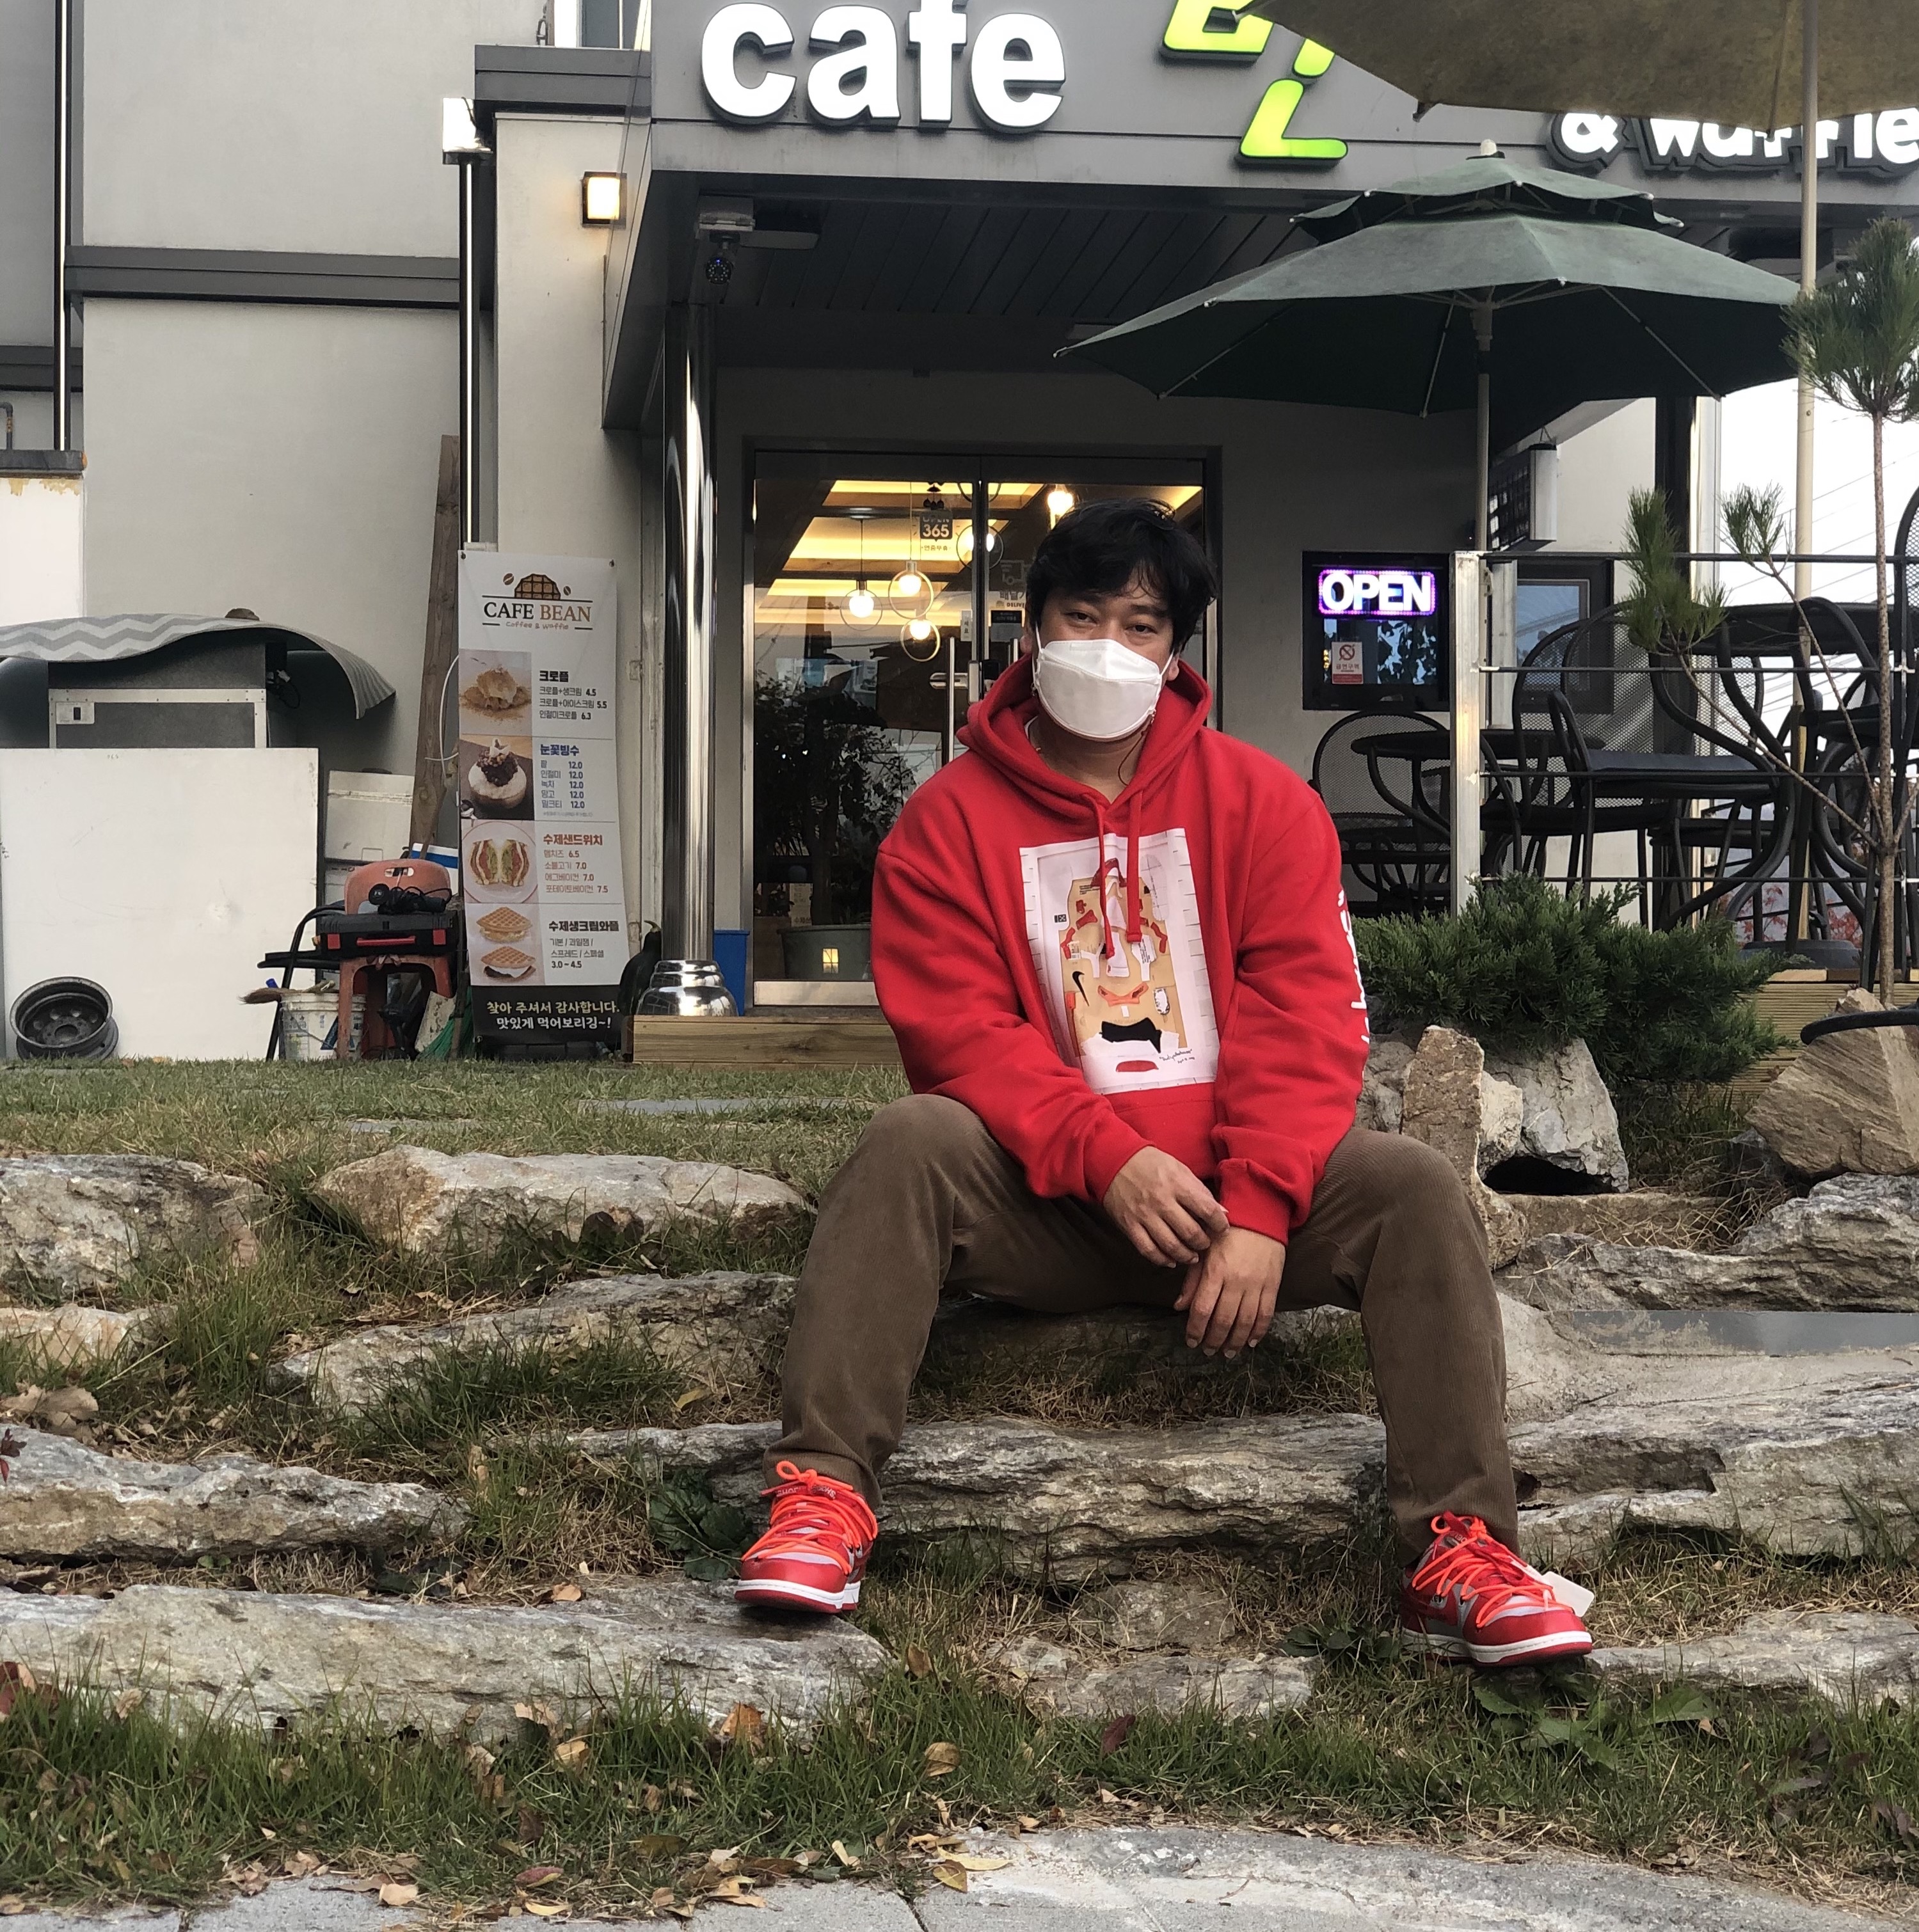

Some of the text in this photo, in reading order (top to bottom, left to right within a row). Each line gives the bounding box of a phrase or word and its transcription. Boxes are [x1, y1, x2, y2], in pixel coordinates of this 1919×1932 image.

[701, 0, 1066, 131] cafe
[1650, 107, 1919, 164] wale
[922, 524, 950, 537] 365
[1322, 572, 1432, 612] OPEN
[484, 601, 591, 622] CAFE BEAN
[539, 670, 568, 682] 크로플
[539, 686, 582, 696] 크로플+생크림
[539, 698, 594, 708] 크로플+아이스크림
[539, 710, 577, 720] 인절미크로플
[540, 744, 579, 756] 눈꽃빙수
[541, 770, 561, 779] 인절미
[543, 834, 603, 845] 수제샌드위치
[545, 873, 579, 882] 에그베이컨
[546, 885, 594, 894] 포테이토베이컨
[549, 921, 619, 931] 수제생크림와플
[487, 1001, 620, 1015] 찾아 주셔서 감사합니다.
[497, 1017, 534, 1030] 맛있게
